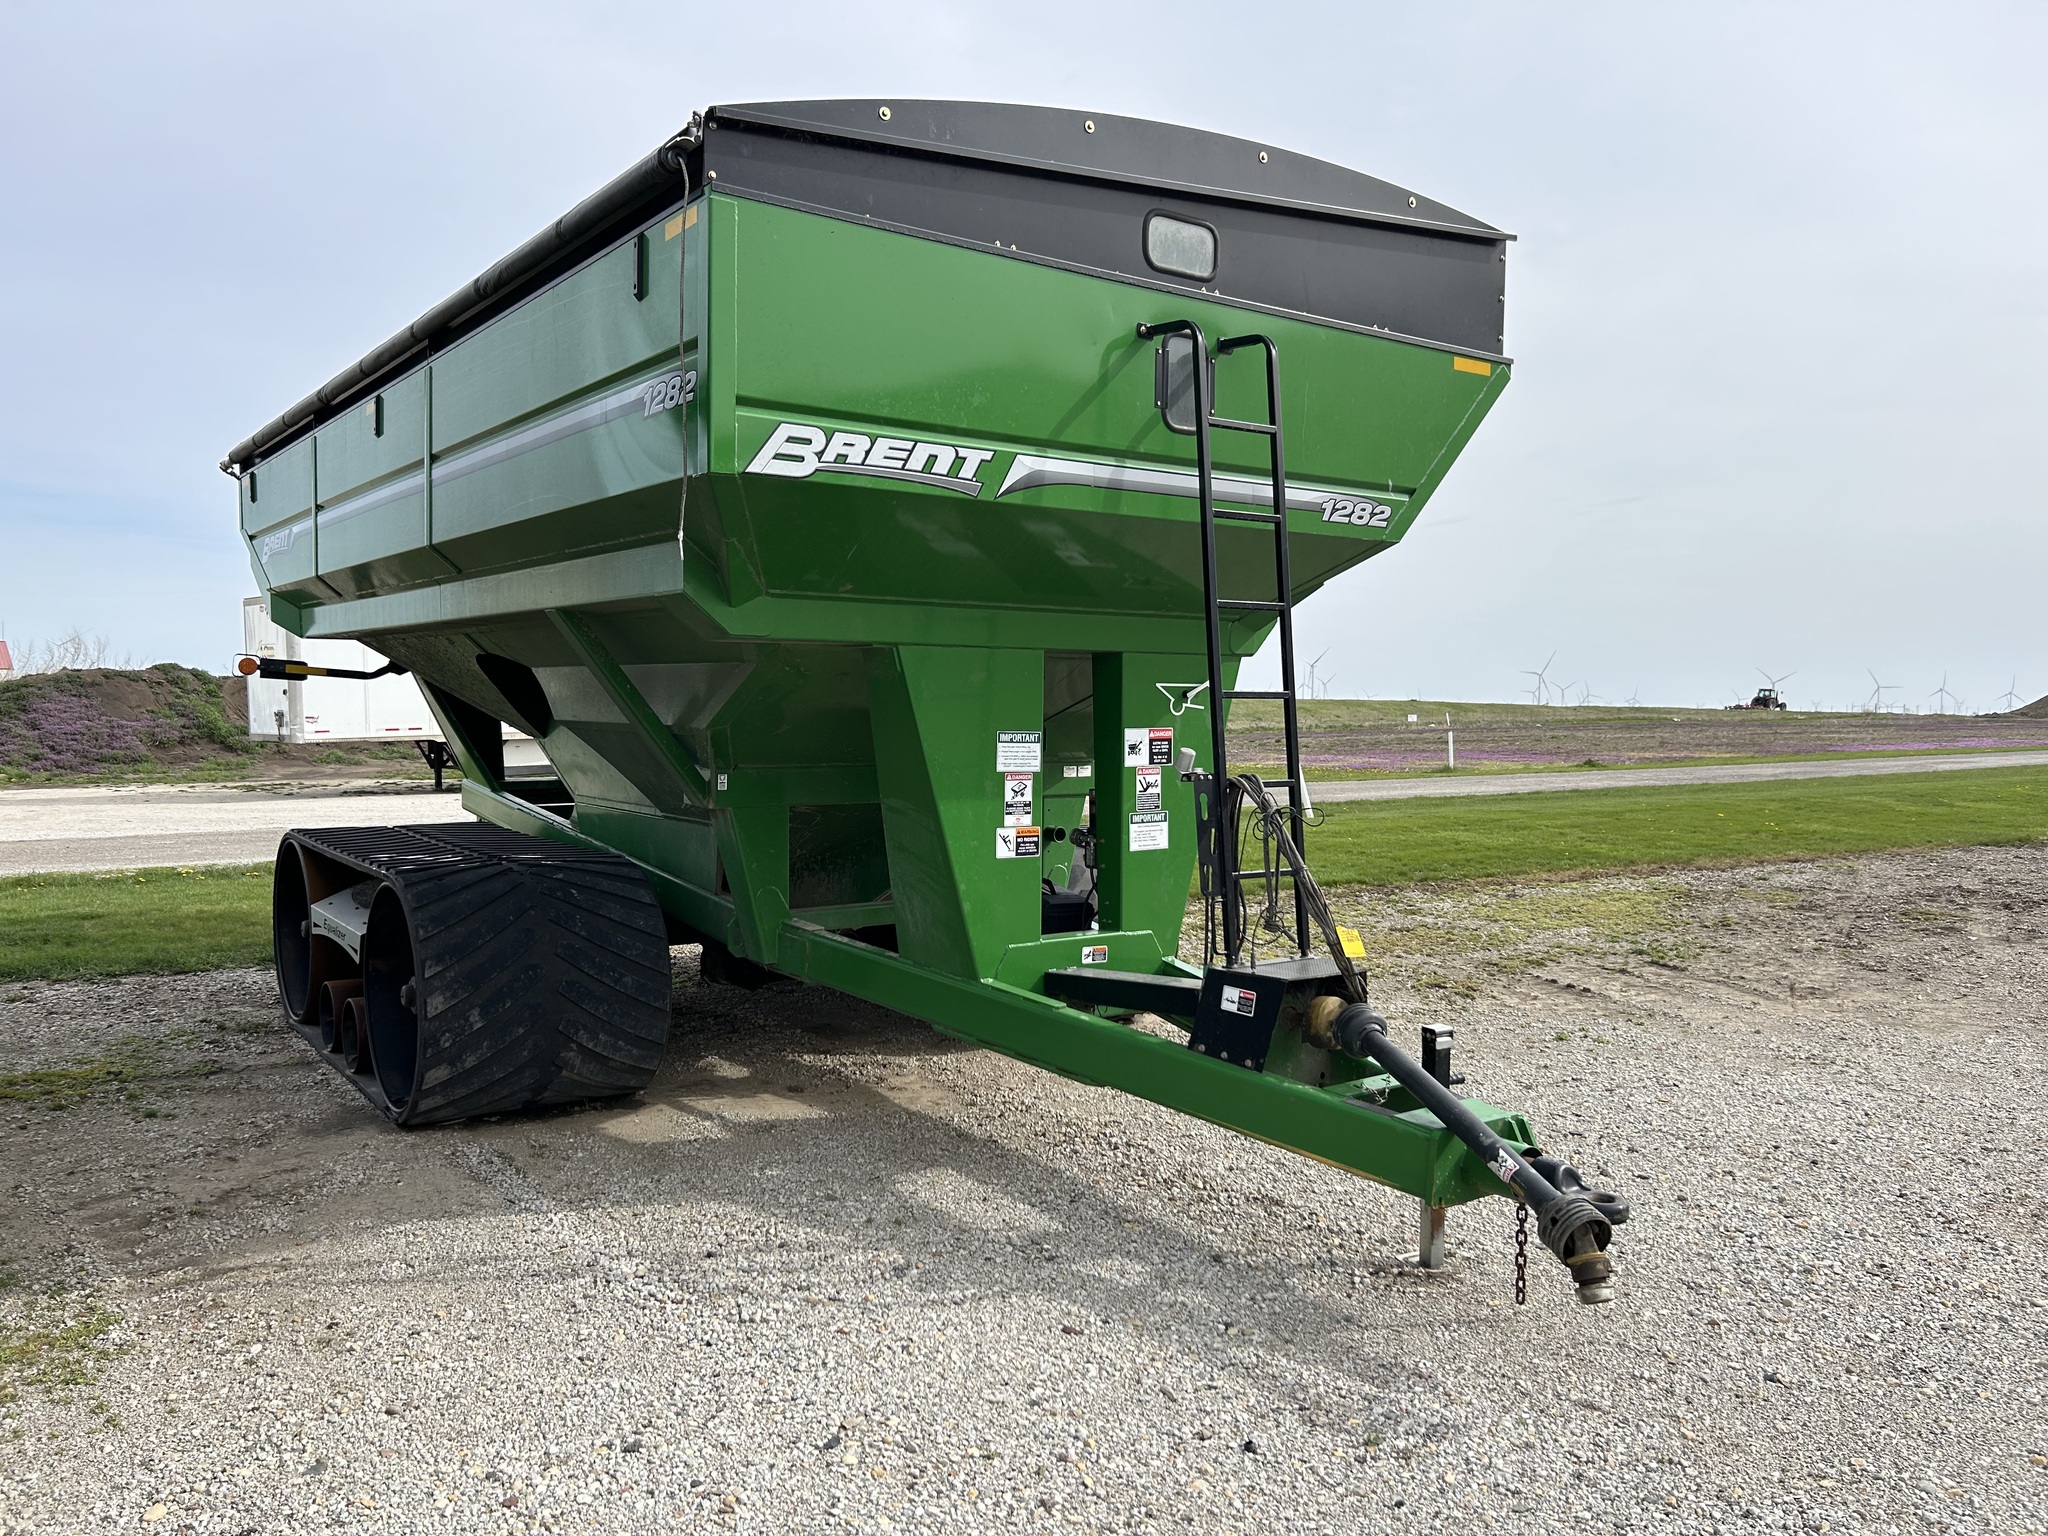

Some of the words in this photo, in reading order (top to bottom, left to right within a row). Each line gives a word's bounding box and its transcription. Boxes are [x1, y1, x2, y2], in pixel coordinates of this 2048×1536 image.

[643, 370, 698, 418] 1282
[744, 422, 994, 480] BRENT
[1320, 498, 1392, 528] 1282
[999, 733, 1039, 743] IMPORTANT
[1132, 813, 1166, 823] IMPORTANT
